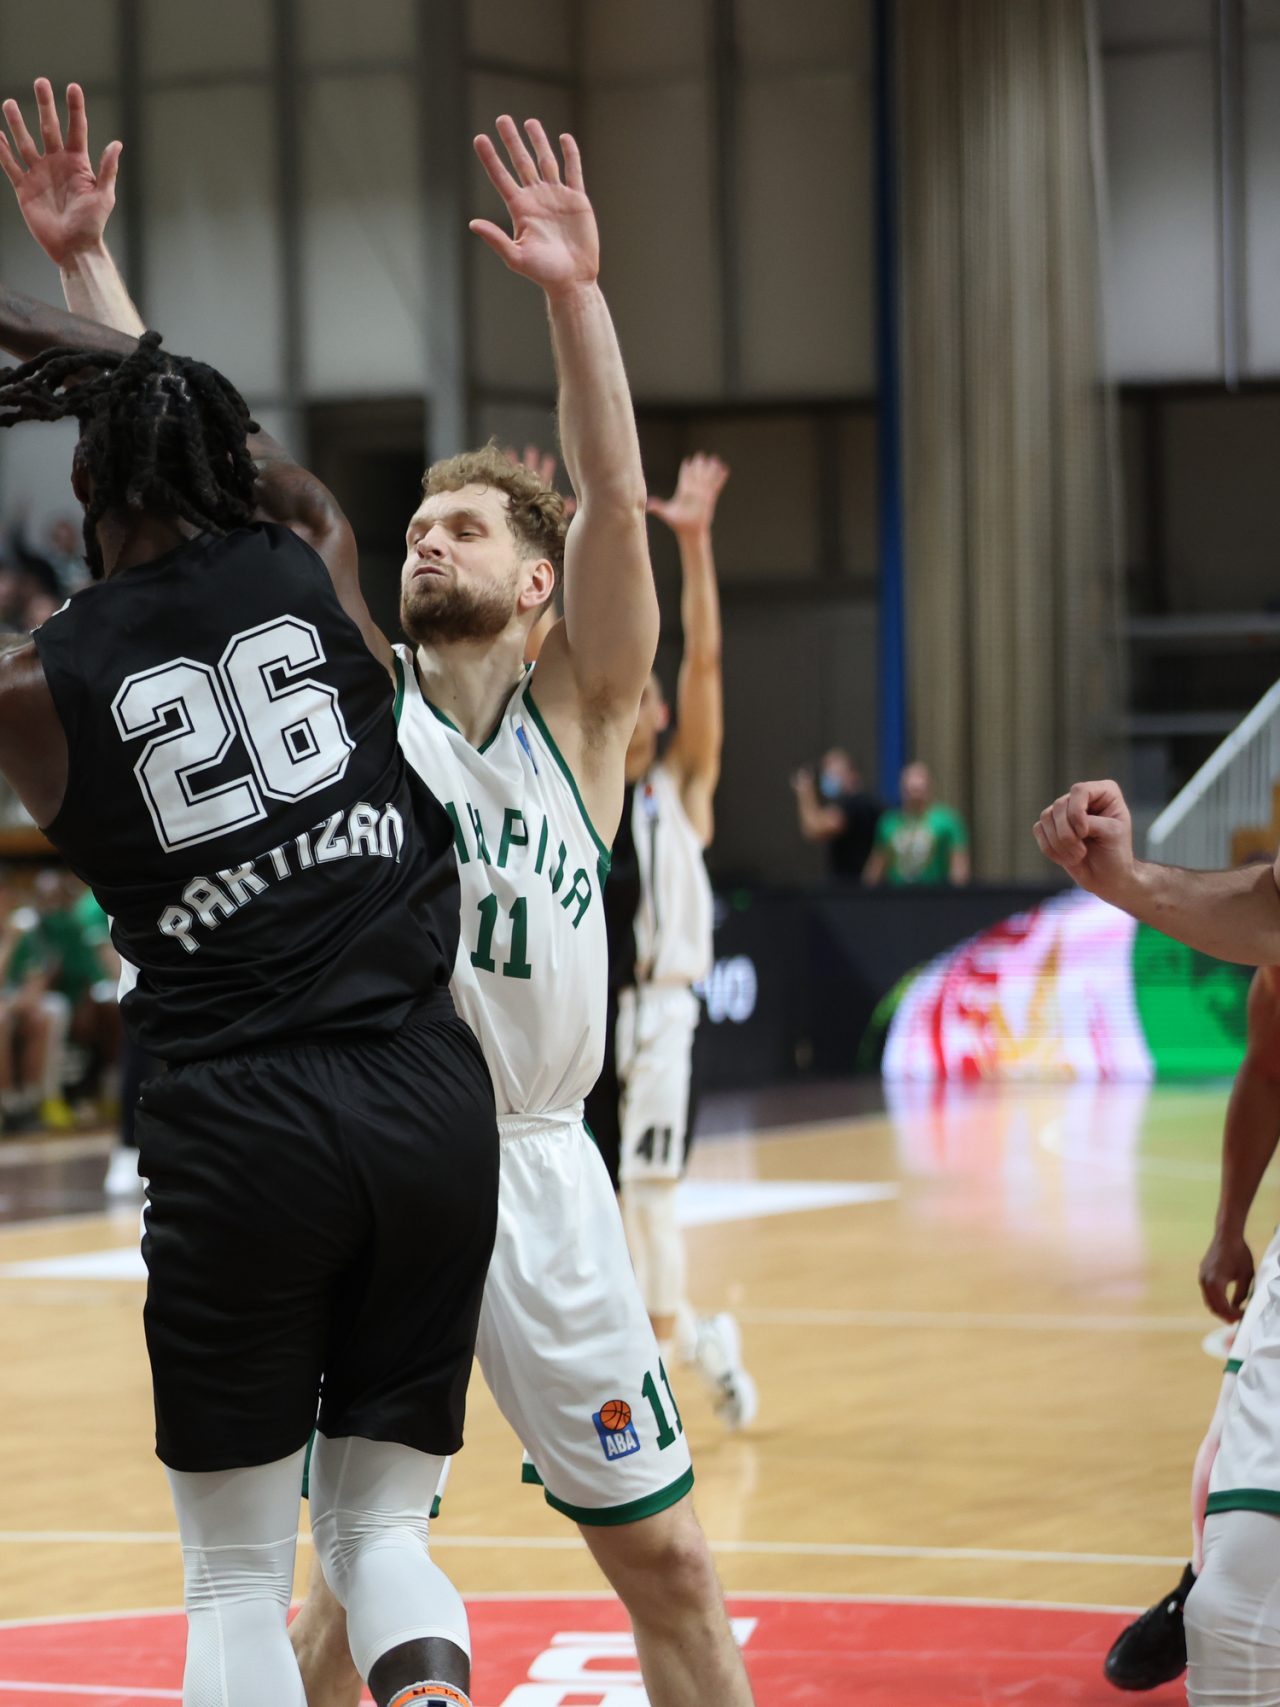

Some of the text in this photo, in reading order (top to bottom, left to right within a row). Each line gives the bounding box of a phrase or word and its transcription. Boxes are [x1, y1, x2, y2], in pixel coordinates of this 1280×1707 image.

[110, 614, 356, 853] 26
[157, 802, 404, 954] PARTIZAN
[470, 892, 532, 980] 11
[635, 1125, 672, 1165] 41
[605, 1429, 638, 1457] ABA
